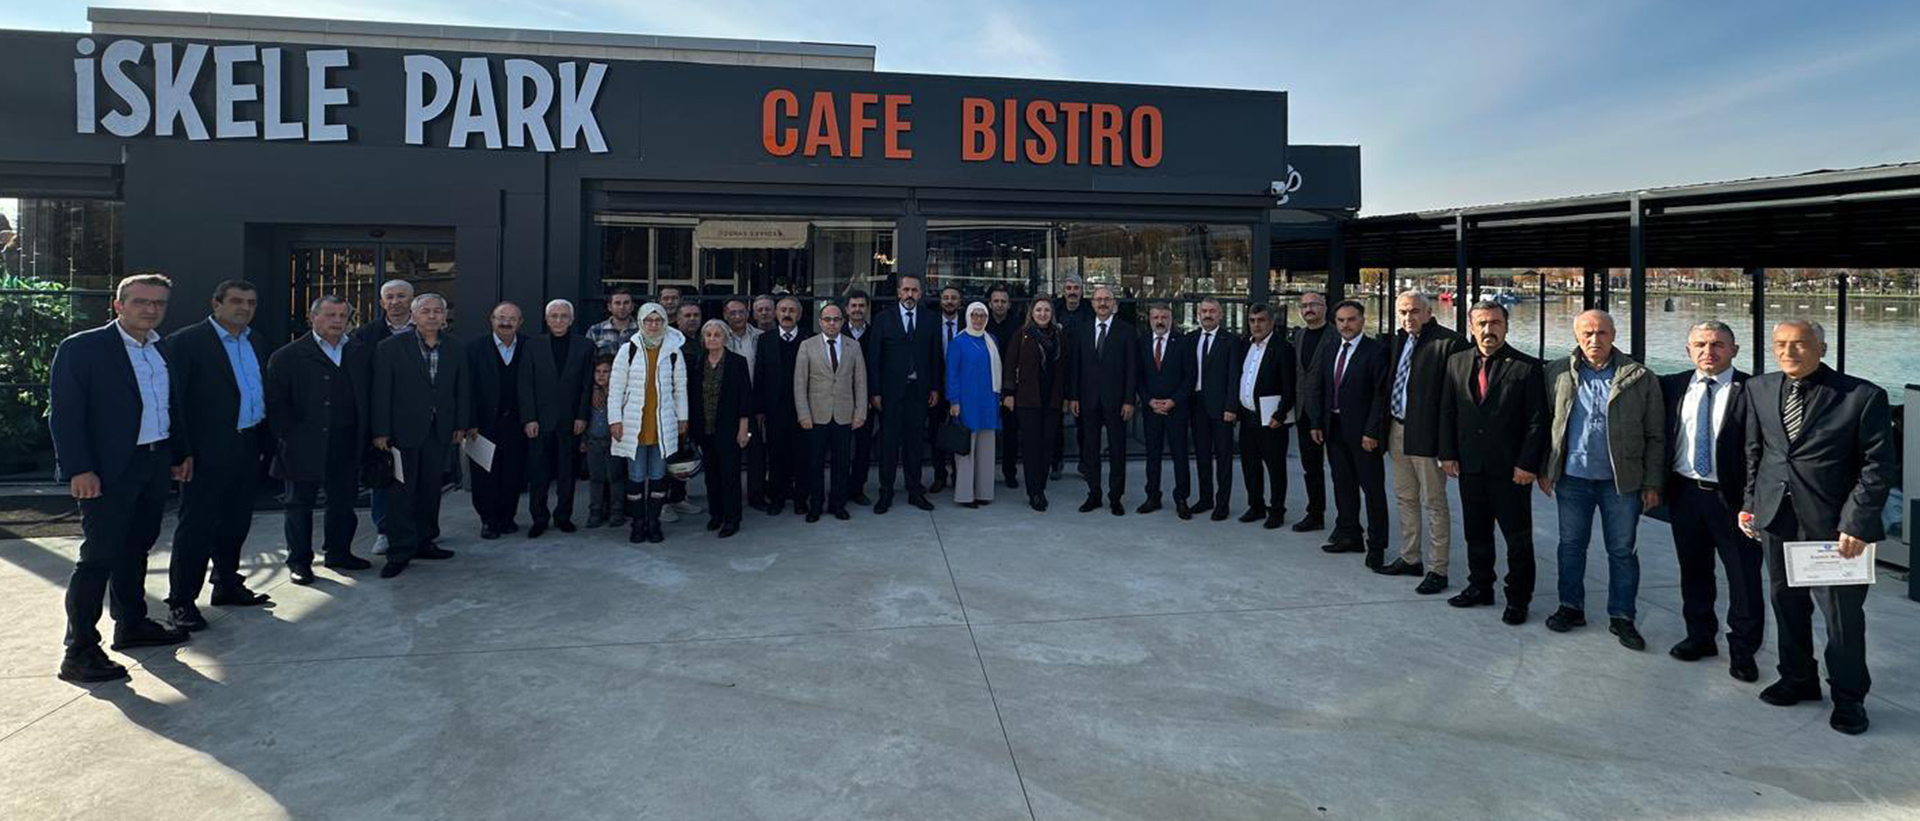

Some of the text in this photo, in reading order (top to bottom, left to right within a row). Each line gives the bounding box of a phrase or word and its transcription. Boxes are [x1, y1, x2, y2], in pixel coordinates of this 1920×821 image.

[403, 54, 609, 153] PARK
[762, 89, 1163, 168] CAFE BISTRO
